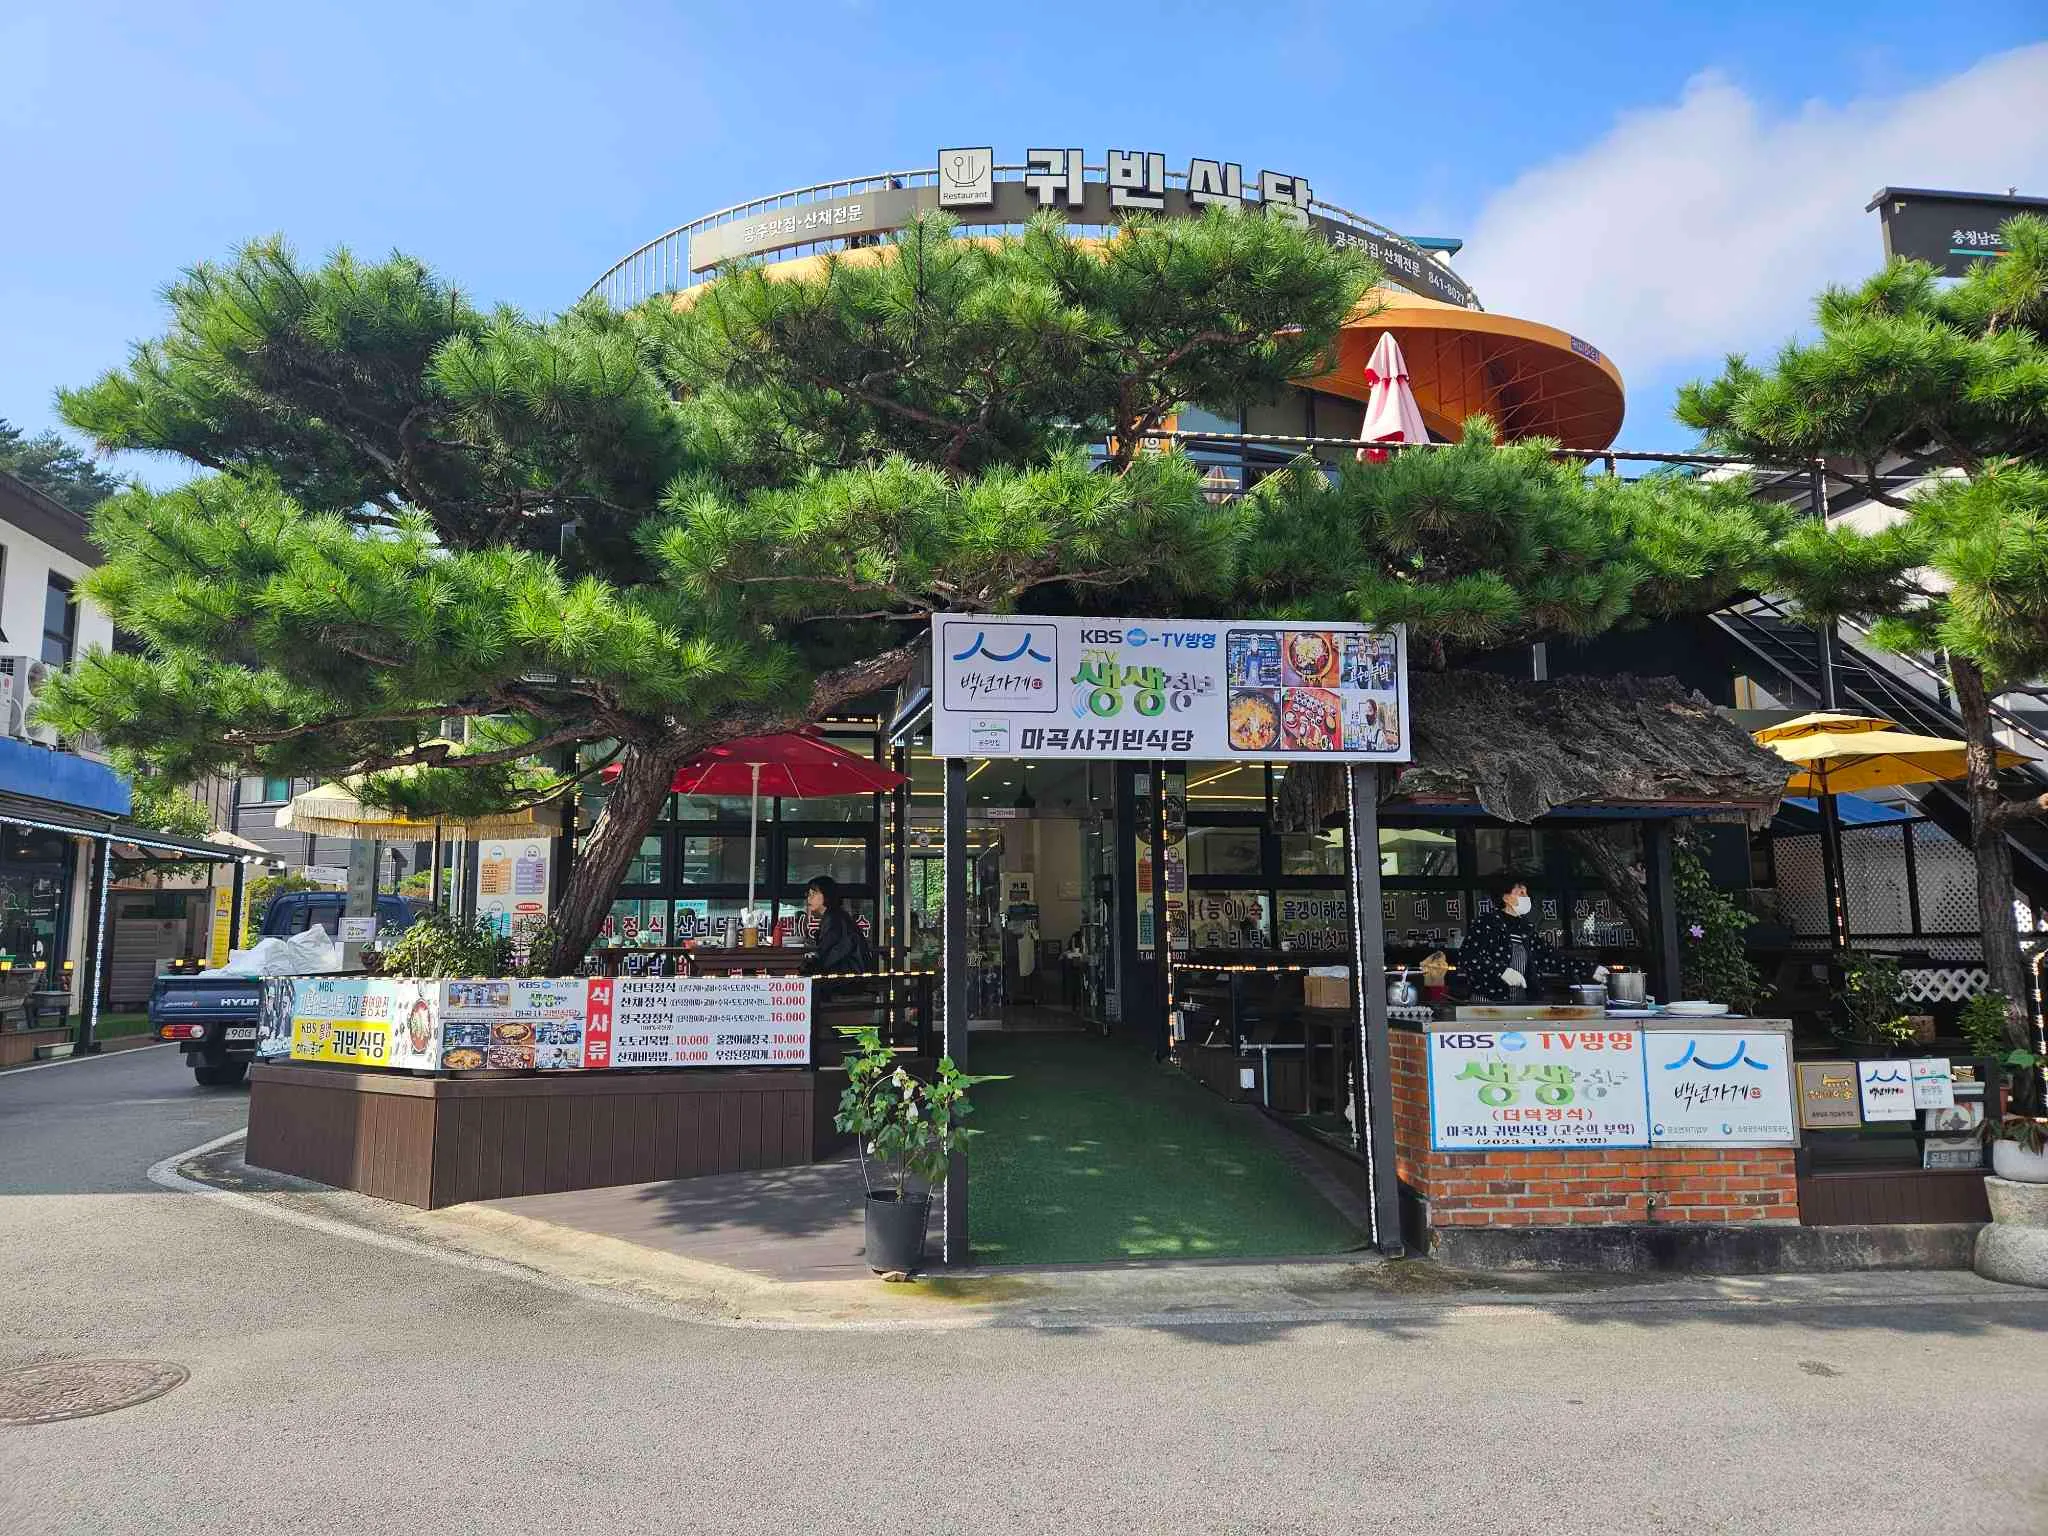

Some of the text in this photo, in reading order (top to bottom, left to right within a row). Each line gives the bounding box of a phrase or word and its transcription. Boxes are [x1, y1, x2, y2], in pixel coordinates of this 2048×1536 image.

[943, 190, 989, 200] Restaurant
[1024, 148, 1314, 227] 귀빈식당
[1952, 229, 2003, 246] 충청남도
[1080, 629, 1123, 644] KBS
[960, 672, 1032, 701] 백년가게
[1021, 728, 1195, 752] 마곡사귀빈식당
[587, 984, 611, 1062] 식사류
[332, 1030, 386, 1058] 귀빈식당
[1439, 1031, 1633, 1051] KBS TV방영
[1675, 1082, 1749, 1112] 백년가게
[1446, 1125, 1488, 1137] 마곡사
[1494, 1125, 1548, 1137] 귀빈식당
